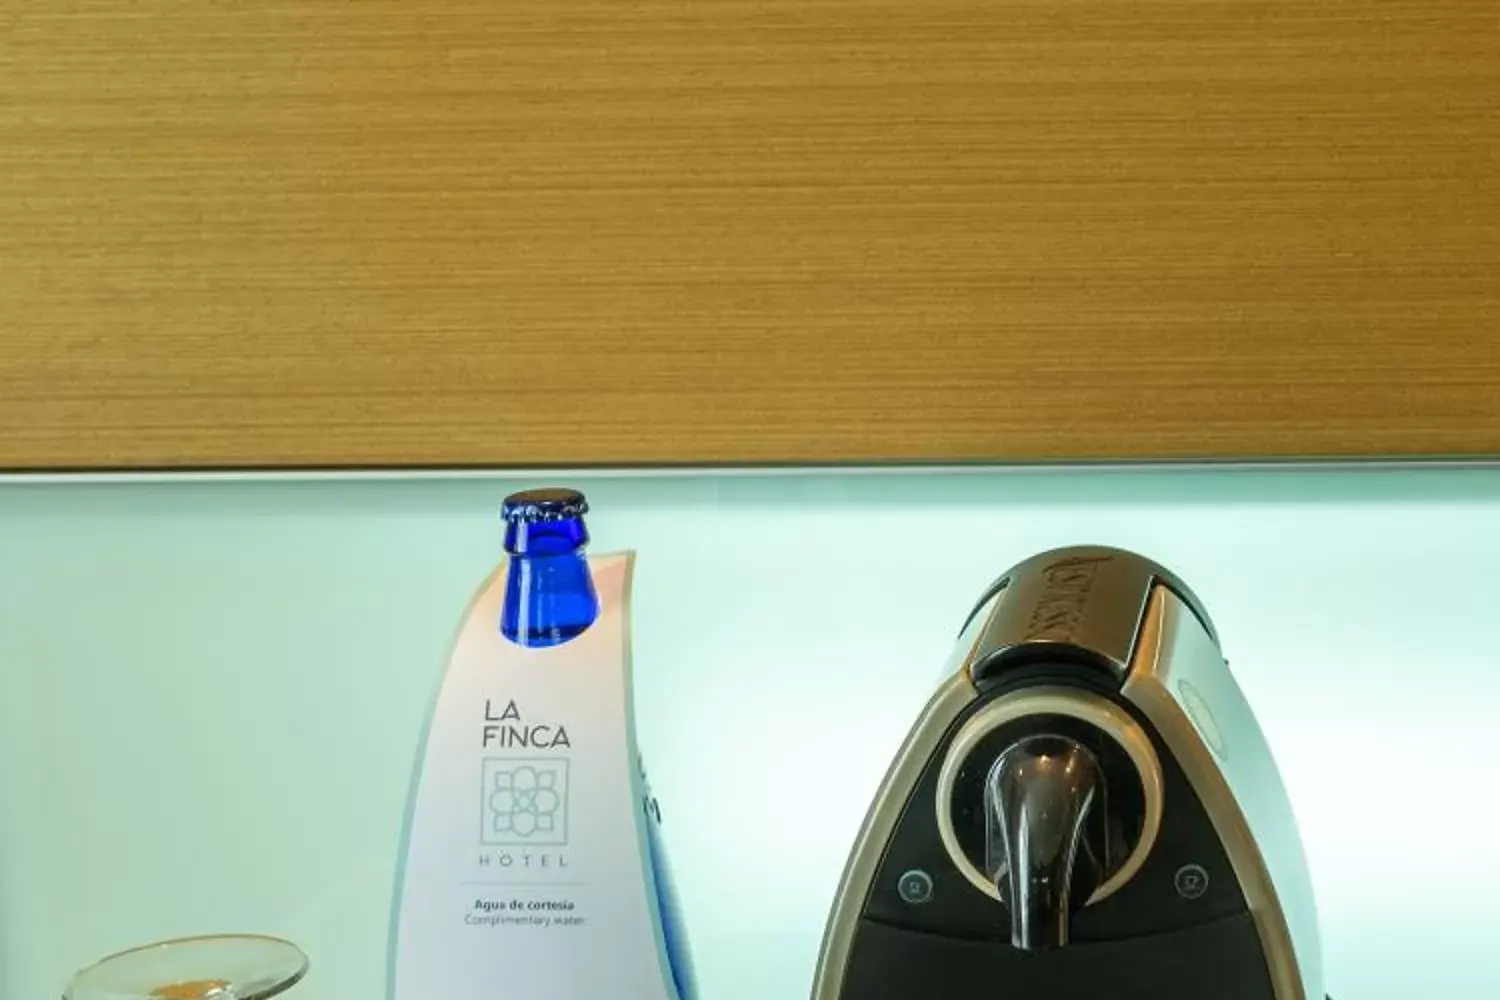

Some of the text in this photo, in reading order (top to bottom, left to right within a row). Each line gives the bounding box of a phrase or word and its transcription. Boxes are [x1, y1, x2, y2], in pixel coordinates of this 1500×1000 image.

[484, 699, 520, 722] LA
[482, 725, 571, 749] FINCA
[478, 854, 568, 868] HOTEL
[474, 899, 507, 912] Agua
[509, 899, 524, 911] de
